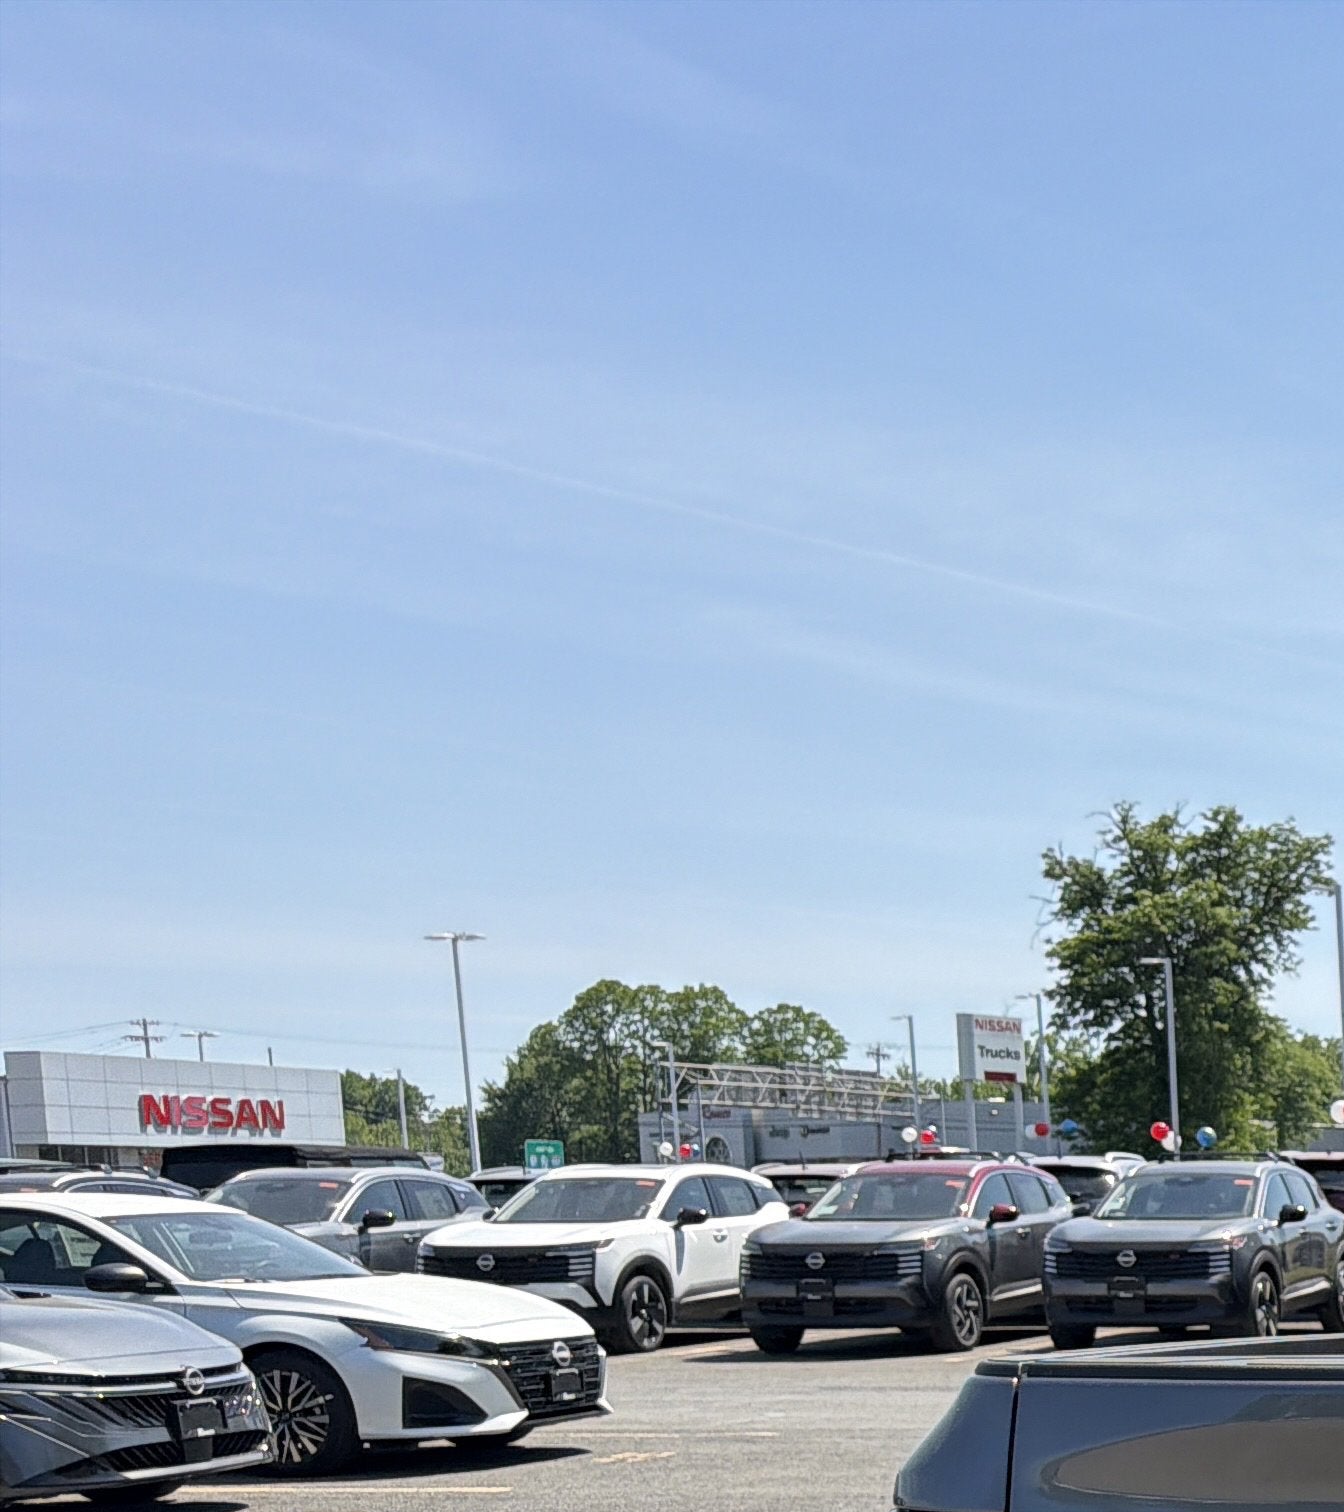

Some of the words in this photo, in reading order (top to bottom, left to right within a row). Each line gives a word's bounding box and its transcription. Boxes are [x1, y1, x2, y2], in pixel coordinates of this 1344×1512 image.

[975, 1018, 1021, 1034] NISSAN
[977, 1044, 1021, 1061] Trucks
[140, 1094, 285, 1131] NISSAN
